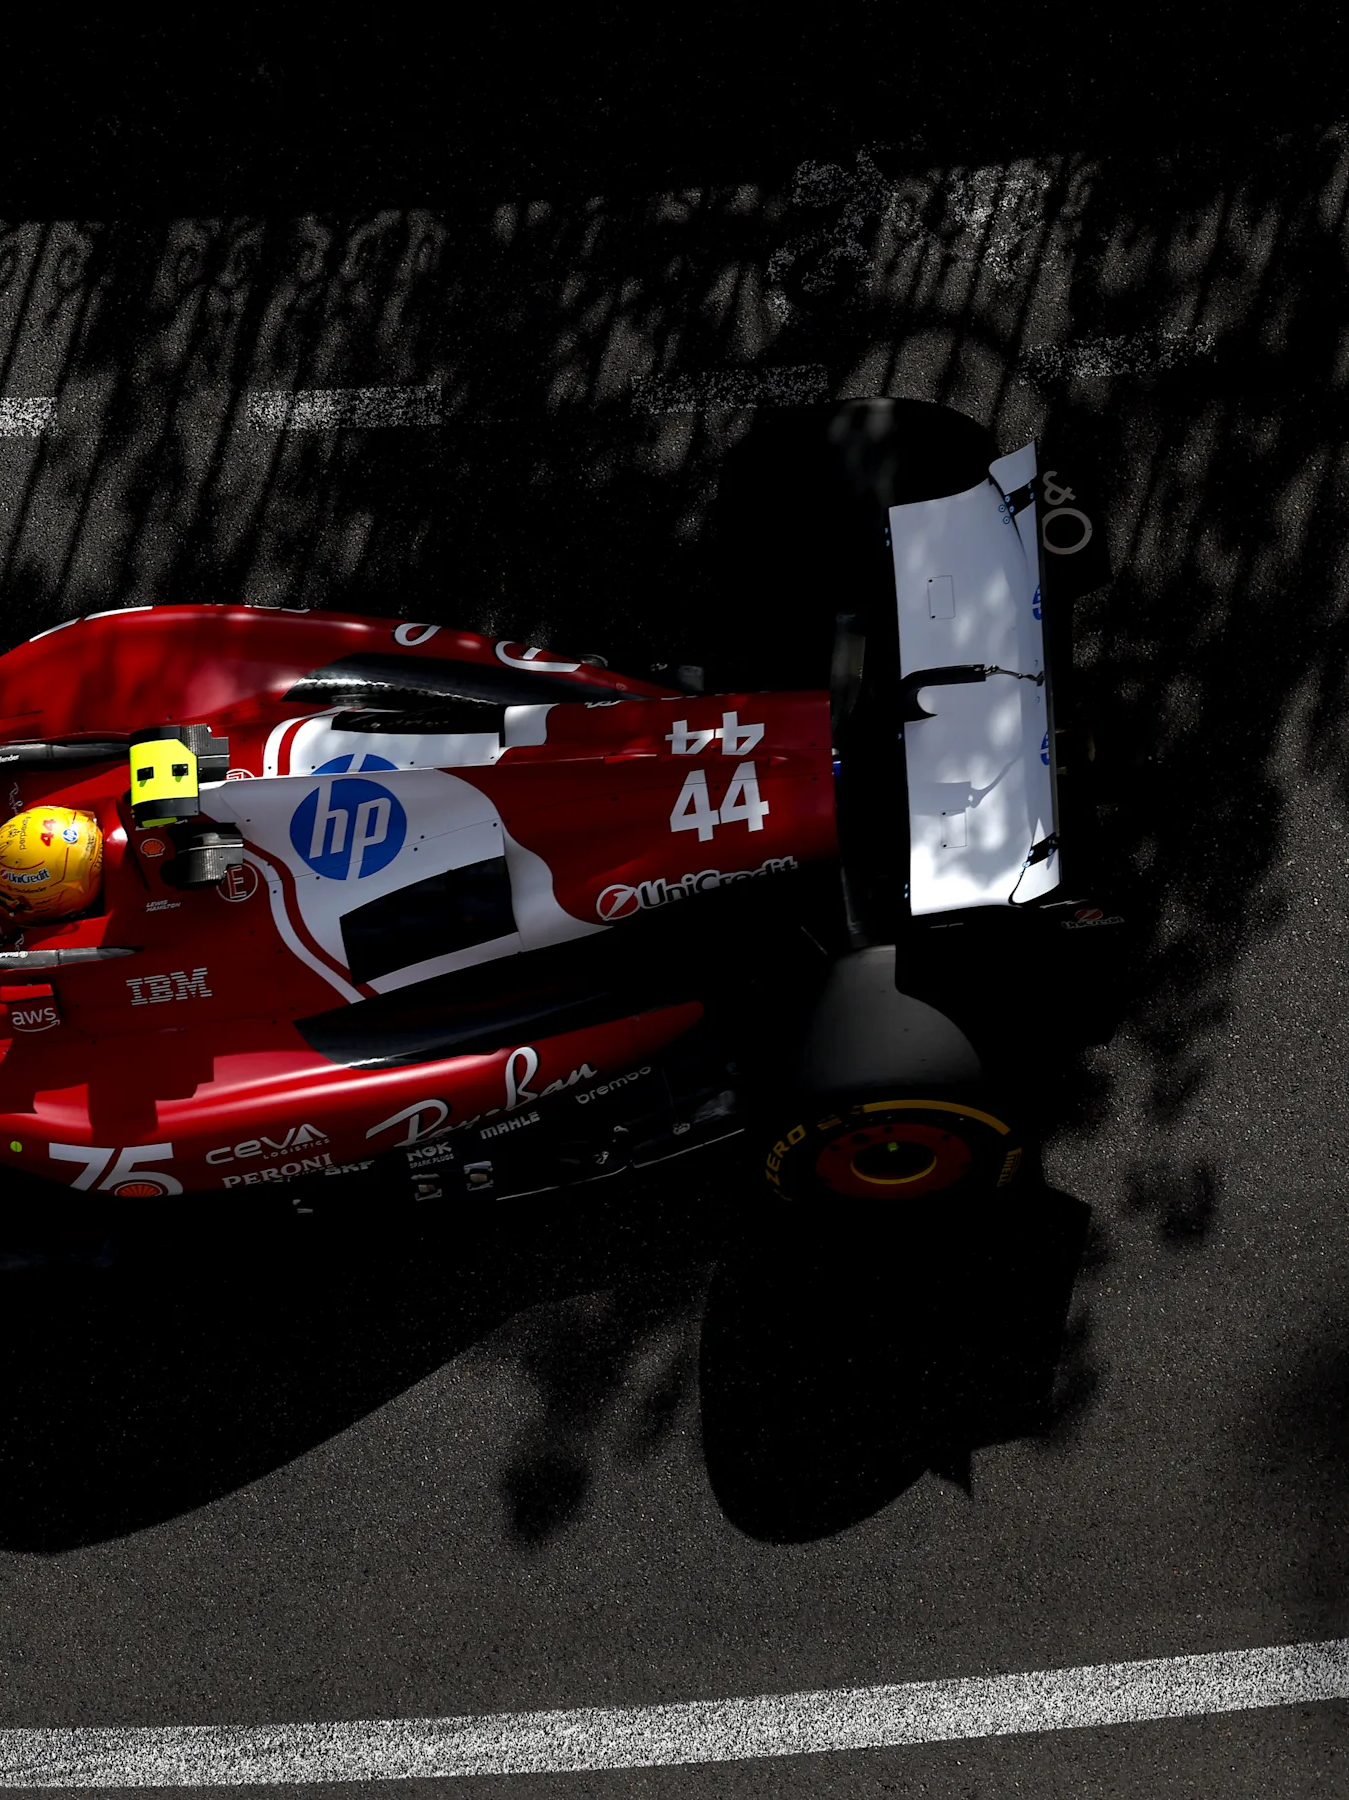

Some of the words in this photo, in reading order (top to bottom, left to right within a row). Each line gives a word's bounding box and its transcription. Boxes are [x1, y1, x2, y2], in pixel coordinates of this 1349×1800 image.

[665, 711, 765, 756] 44
[669, 761, 769, 842] 44
[40, 819, 56, 847] 44
[306, 778, 396, 880] hp
[8, 868, 50, 884] UniCredit
[126, 967, 213, 1006] IBM
[11, 1006, 57, 1026] aws
[365, 1046, 598, 1148] Ray-Ban
[575, 1066, 652, 1104] brembo
[263, 1138, 331, 1160] LOGISTICS
[406, 1142, 452, 1162] NGK
[763, 1123, 807, 1187] ZERO
[48, 1142, 184, 1196] 75
[221, 1153, 333, 1188] PERONI
